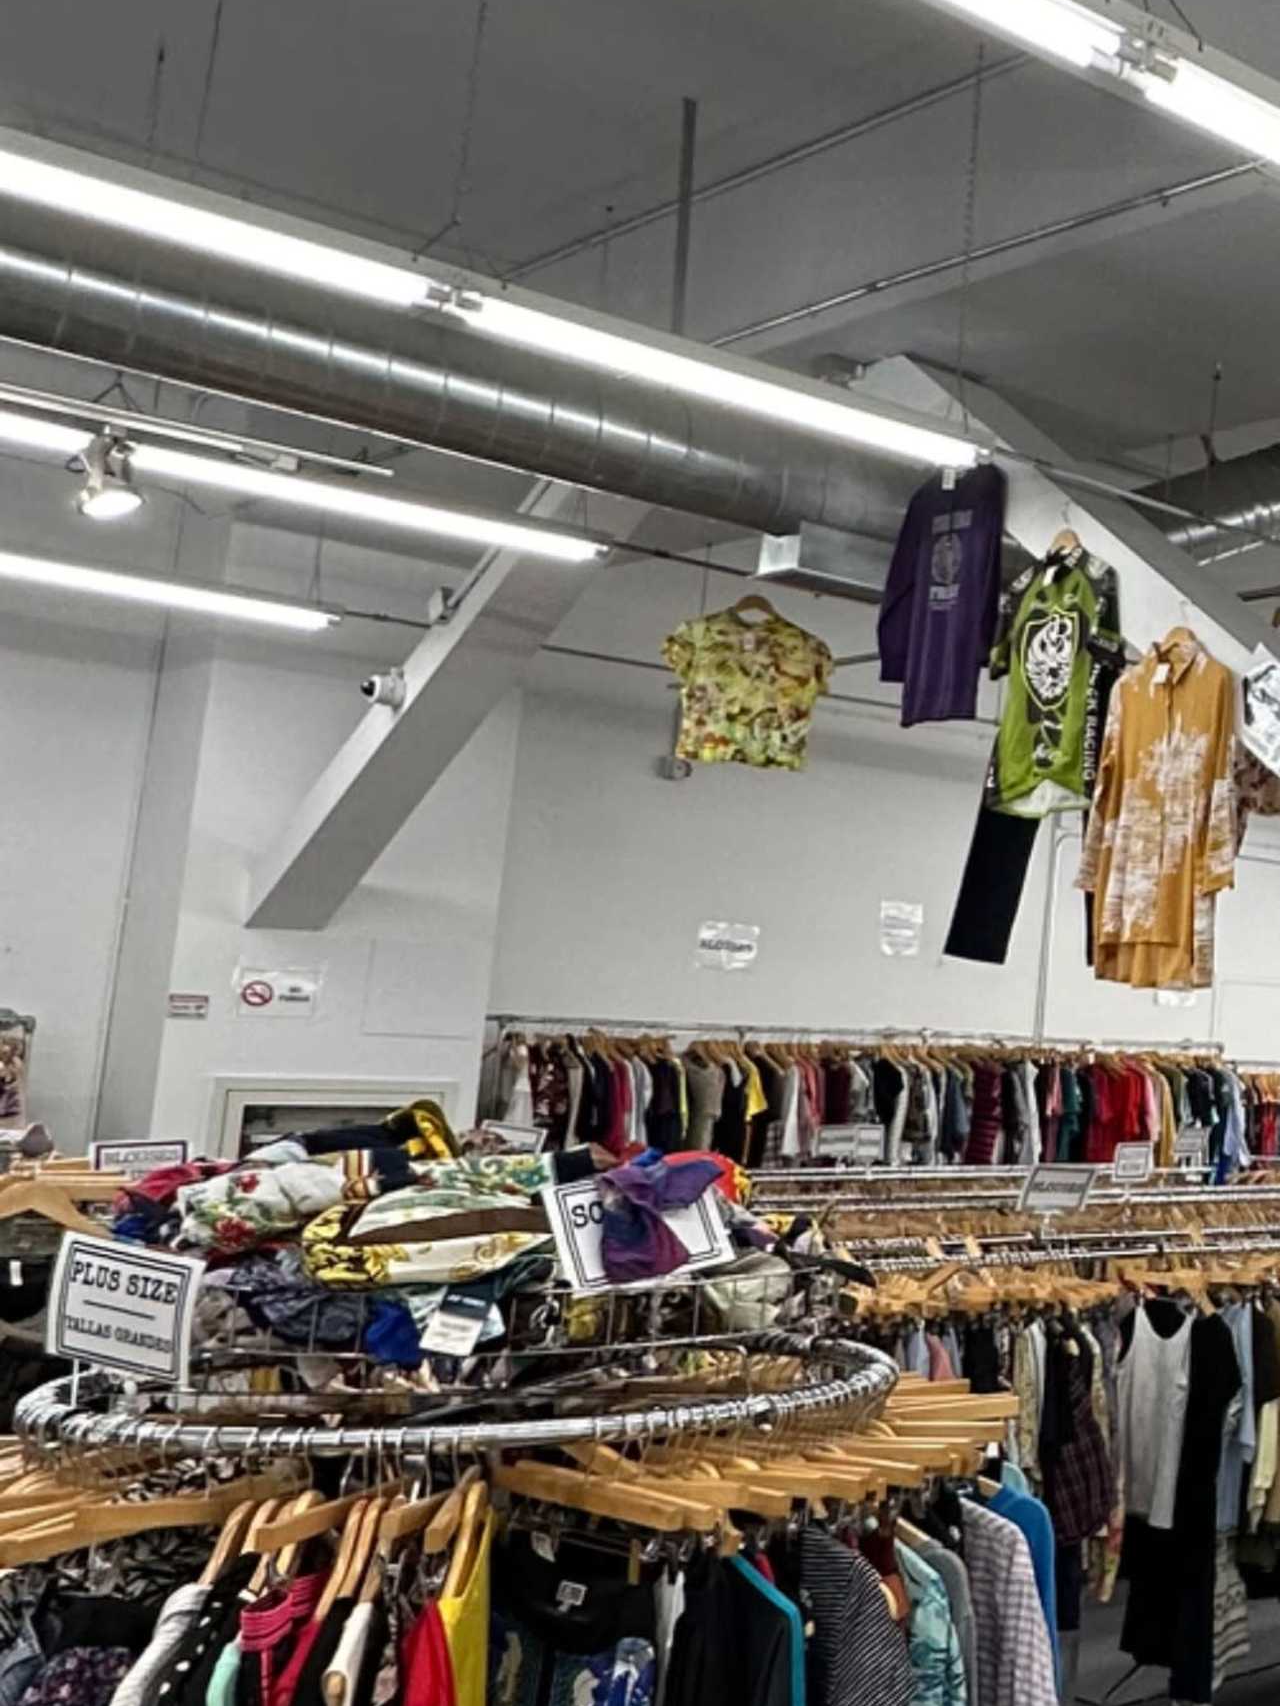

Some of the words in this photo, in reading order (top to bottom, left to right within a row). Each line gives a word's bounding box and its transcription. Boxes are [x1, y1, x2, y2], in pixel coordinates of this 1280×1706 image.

[70, 1261, 121, 1291] PLUS
[126, 1274, 178, 1304] SIZE
[65, 1315, 113, 1339] TALLAS
